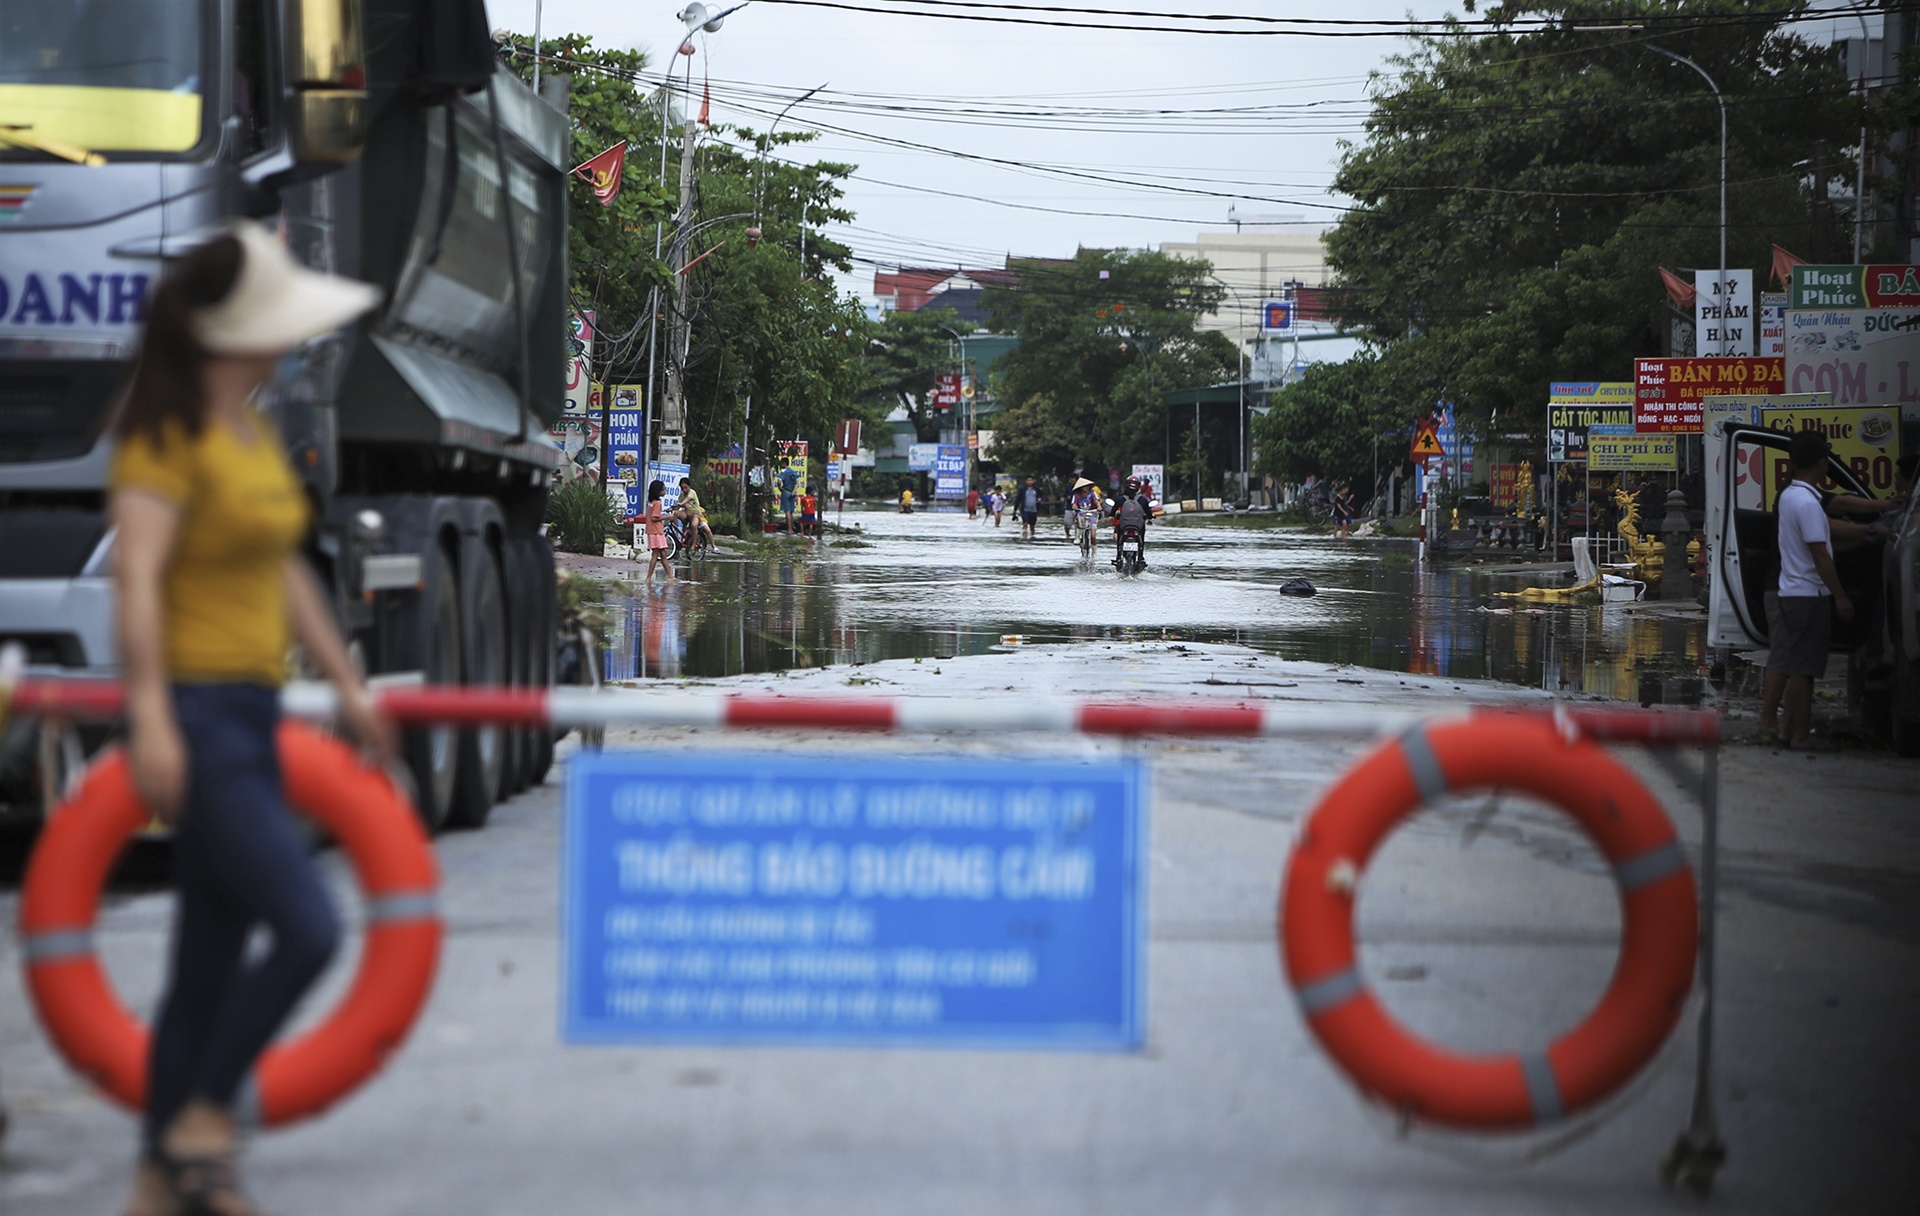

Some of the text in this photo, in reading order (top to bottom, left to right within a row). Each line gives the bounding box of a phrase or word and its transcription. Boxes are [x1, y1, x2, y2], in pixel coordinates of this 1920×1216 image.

[1803, 270, 1854, 289] Hoạt
[0, 272, 148, 324] ANH
[1801, 289, 1857, 305] Phúc
[1793, 313, 1819, 329] Quán
[1640, 362, 1664, 374] Hoạt
[1669, 359, 1784, 386] BÁN MỘ ĐÁ
[1639, 375, 1665, 385] Phúc
[1792, 358, 1869, 404] CƠM
[1680, 385, 1694, 398] ĐÁ
[1696, 385, 1722, 398] GHÉP
[1644, 401, 1664, 413] NHẬN
[1665, 402, 1677, 411] THI
[1678, 401, 1698, 411] CÔNG
[608, 413, 638, 430] HỌN
[1552, 406, 1629, 427] CẮT TÓC NAM
[1663, 414, 1678, 425] HẠC
[1801, 416, 1852, 439] Phúc
[614, 428, 639, 446] PHẦN
[1568, 432, 1585, 449] Huy
[1592, 444, 1618, 454] CHI
[1623, 441, 1648, 454] PHÍ
